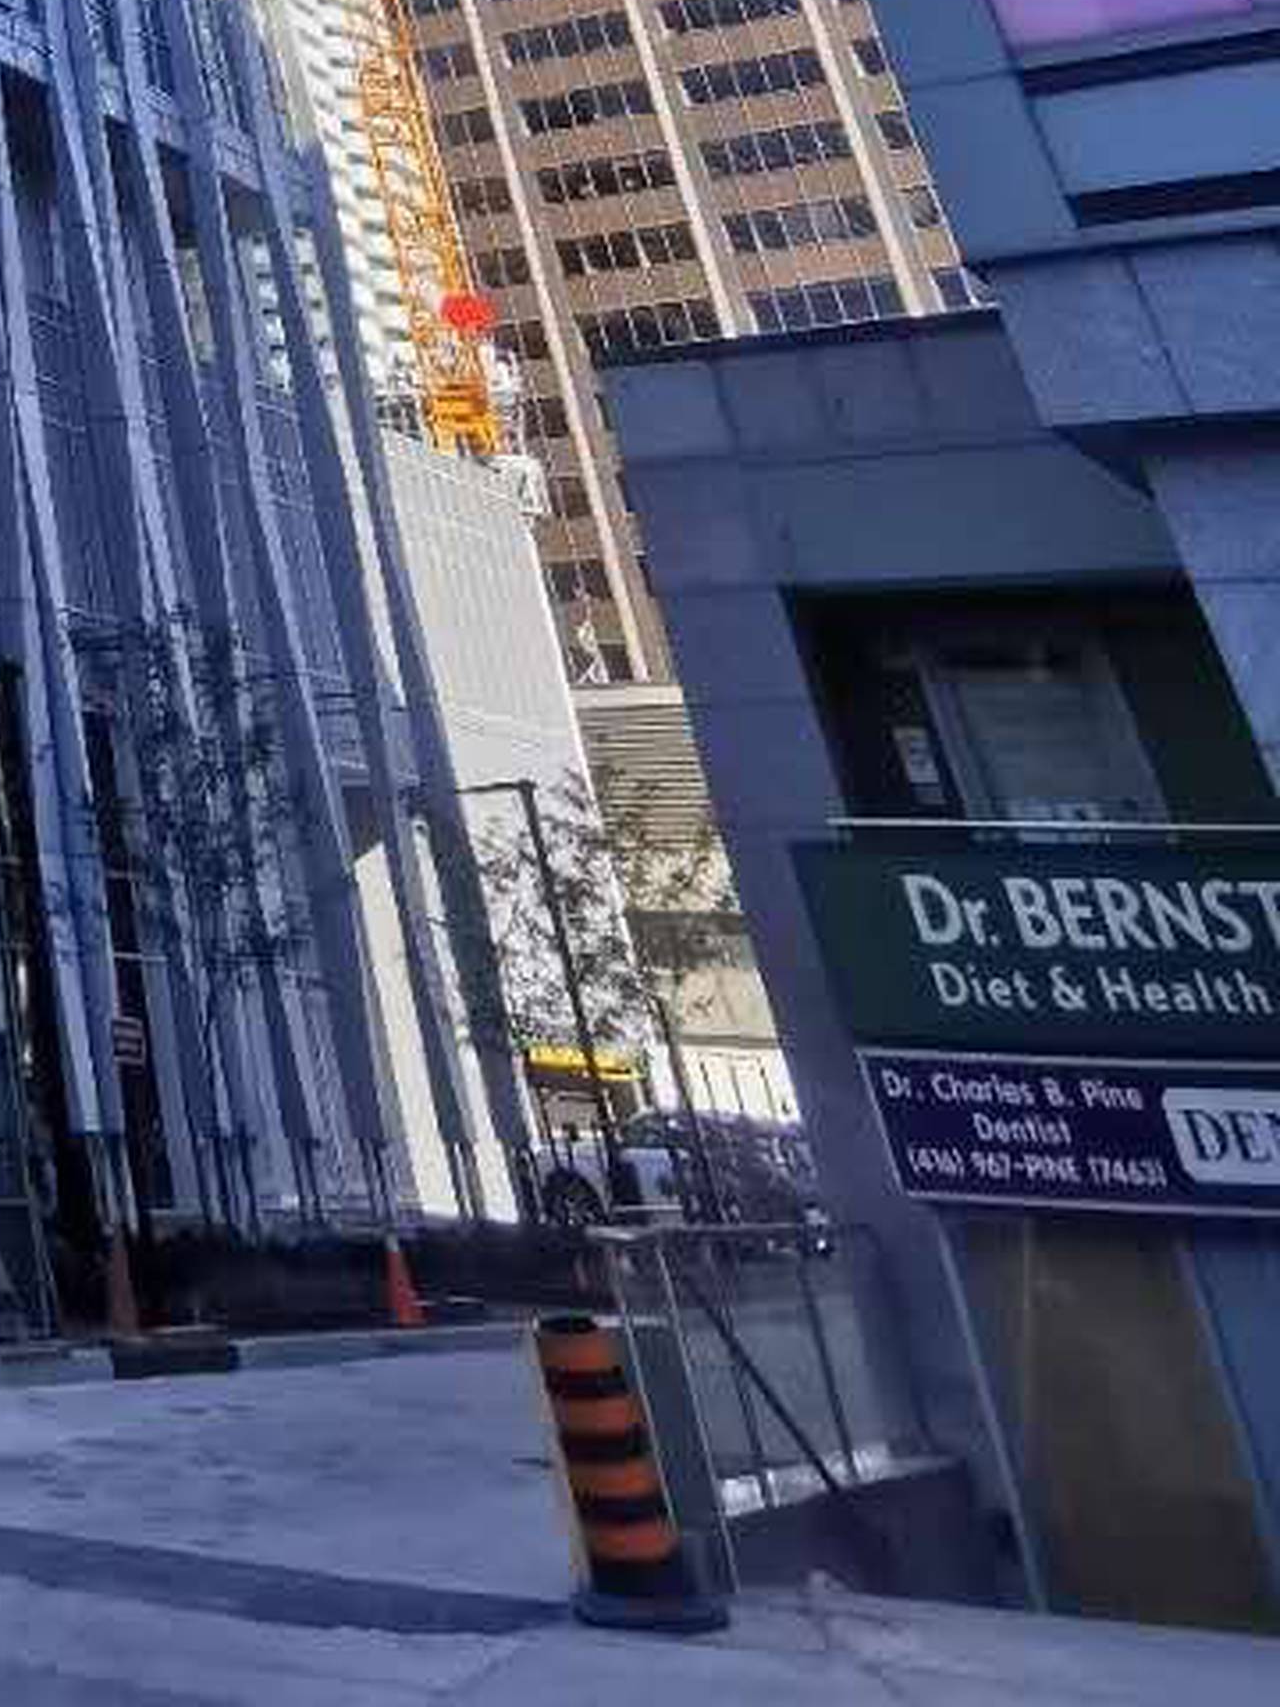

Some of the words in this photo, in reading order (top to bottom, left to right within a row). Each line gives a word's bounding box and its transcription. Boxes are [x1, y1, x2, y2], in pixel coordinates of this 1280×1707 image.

[902, 874, 1000, 946] Dr.
[930, 962, 1038, 1010] Diet
[1049, 965, 1088, 1012] &
[1097, 966, 1274, 1014] Health
[880, 1069, 924, 1101] Dr.
[931, 1073, 1035, 1106] Charles
[1042, 1077, 1076, 1108] B.
[1080, 1079, 1144, 1110] Pine
[972, 1112, 1072, 1145] Dentist
[1183, 1108, 1280, 1163] DE
[907, 1147, 966, 1177] (416)
[971, 1152, 1081, 1184] 967-PINE
